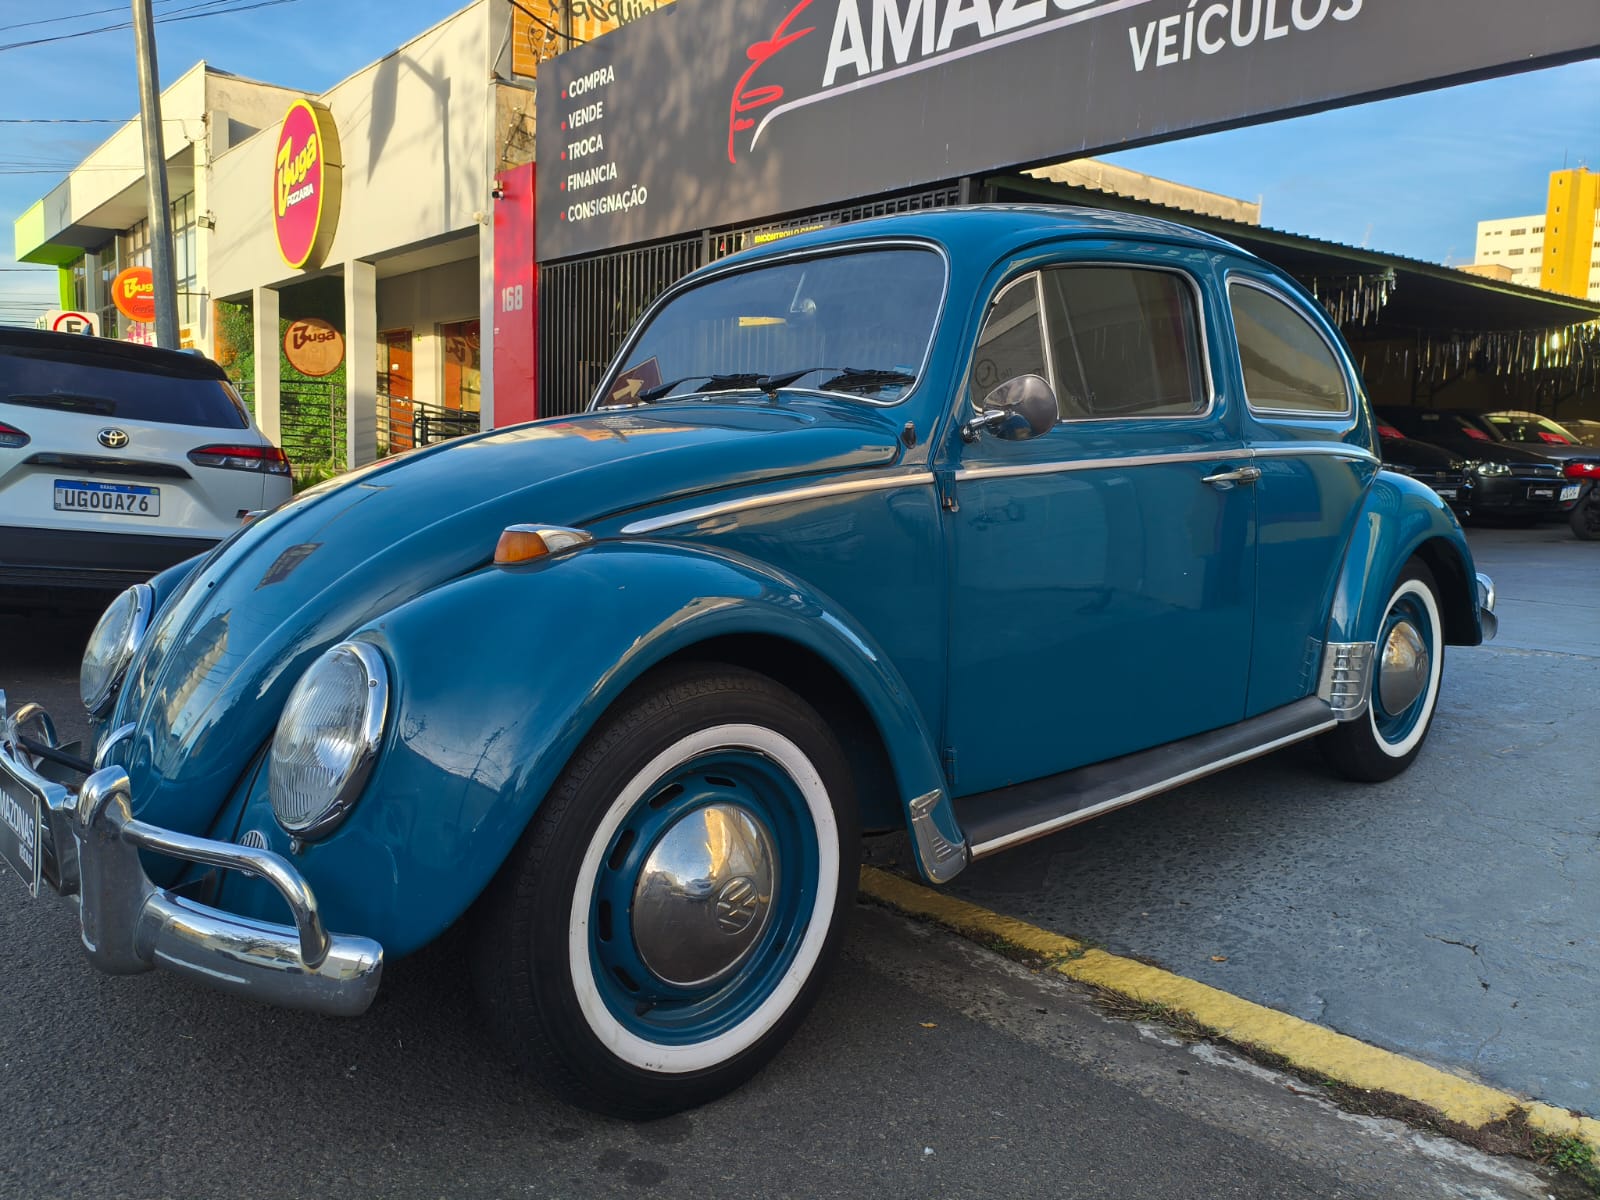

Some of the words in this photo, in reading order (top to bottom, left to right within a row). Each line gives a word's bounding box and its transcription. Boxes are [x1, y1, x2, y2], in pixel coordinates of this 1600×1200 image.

[822, 0, 1098, 88] AMA
[569, 65, 615, 98] COMPRA
[568, 101, 603, 129] VENDE
[568, 134, 603, 160] TROCA
[568, 162, 617, 192] FINANCIA
[568, 184, 647, 222] CONSIGNAÇÃO
[123, 277, 154, 298] Bug
[502, 285, 523, 312] 168
